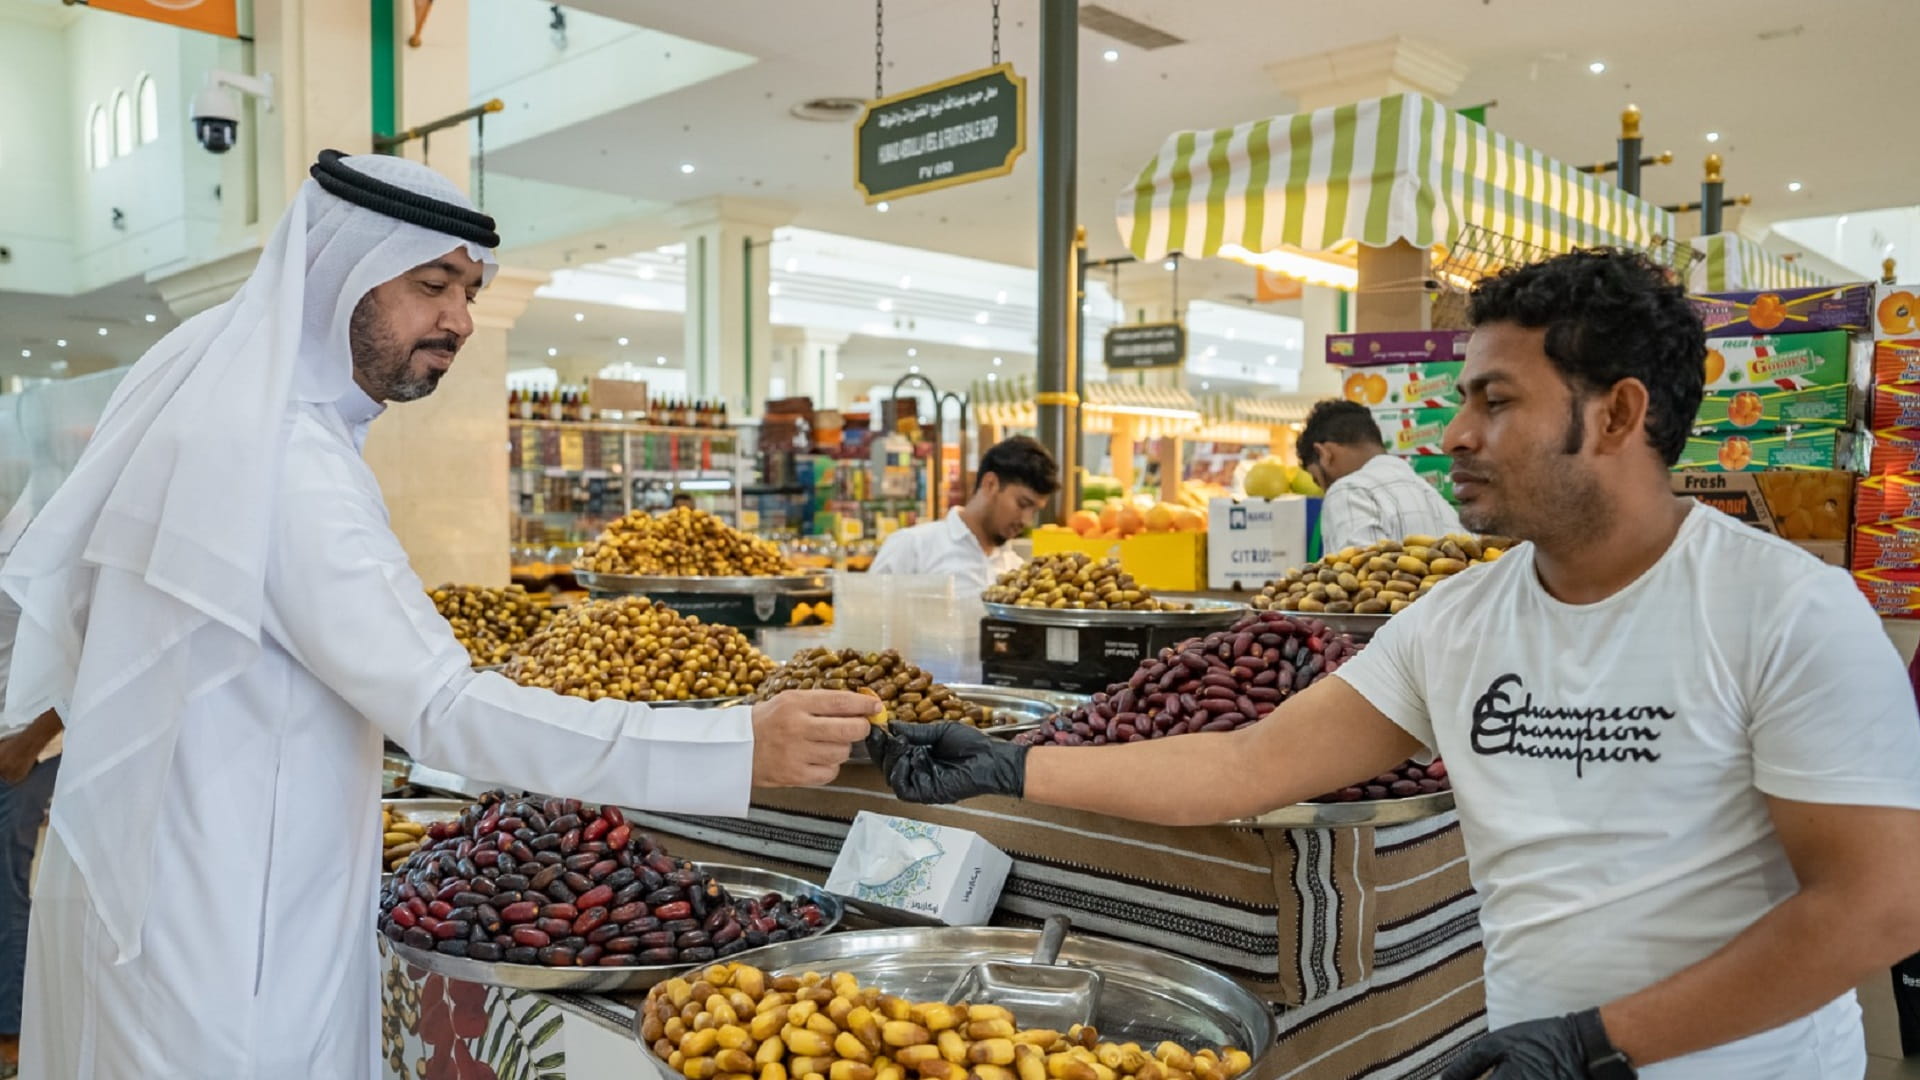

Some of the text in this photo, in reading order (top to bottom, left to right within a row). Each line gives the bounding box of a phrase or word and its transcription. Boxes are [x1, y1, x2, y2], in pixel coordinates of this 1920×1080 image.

[965, 119, 980, 144] SALE
[981, 115, 998, 139] SHOP
[1685, 474, 1726, 489] Fresh
